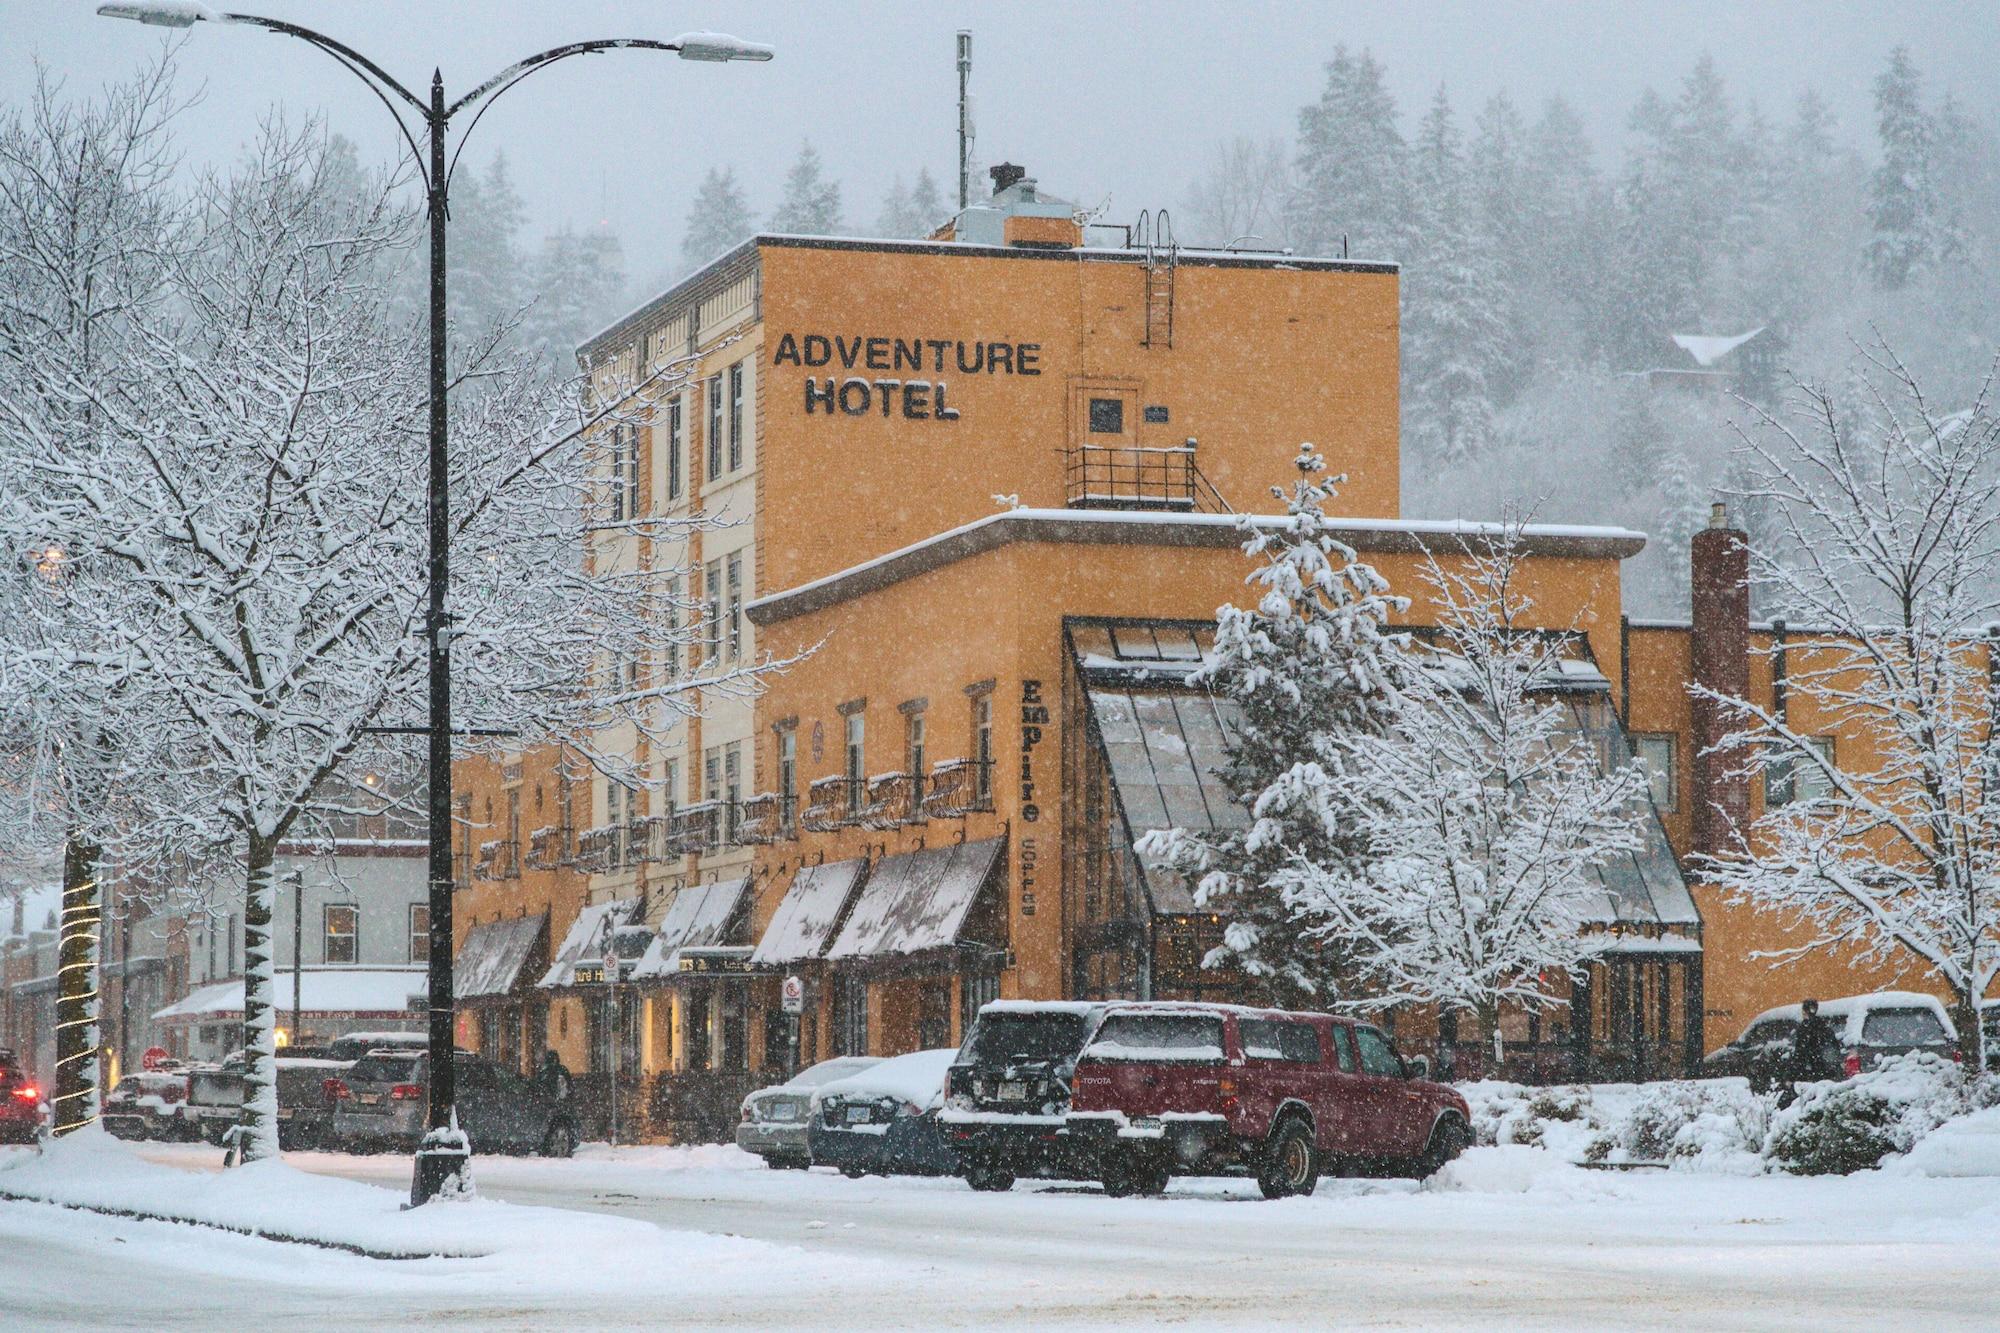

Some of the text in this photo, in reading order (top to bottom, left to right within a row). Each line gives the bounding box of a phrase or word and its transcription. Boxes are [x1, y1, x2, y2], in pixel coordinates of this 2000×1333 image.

[774, 333, 1041, 375] ADVENTURE
[805, 376, 960, 420] HOTEL
[1083, 1077, 1112, 1085] TOYOTA
